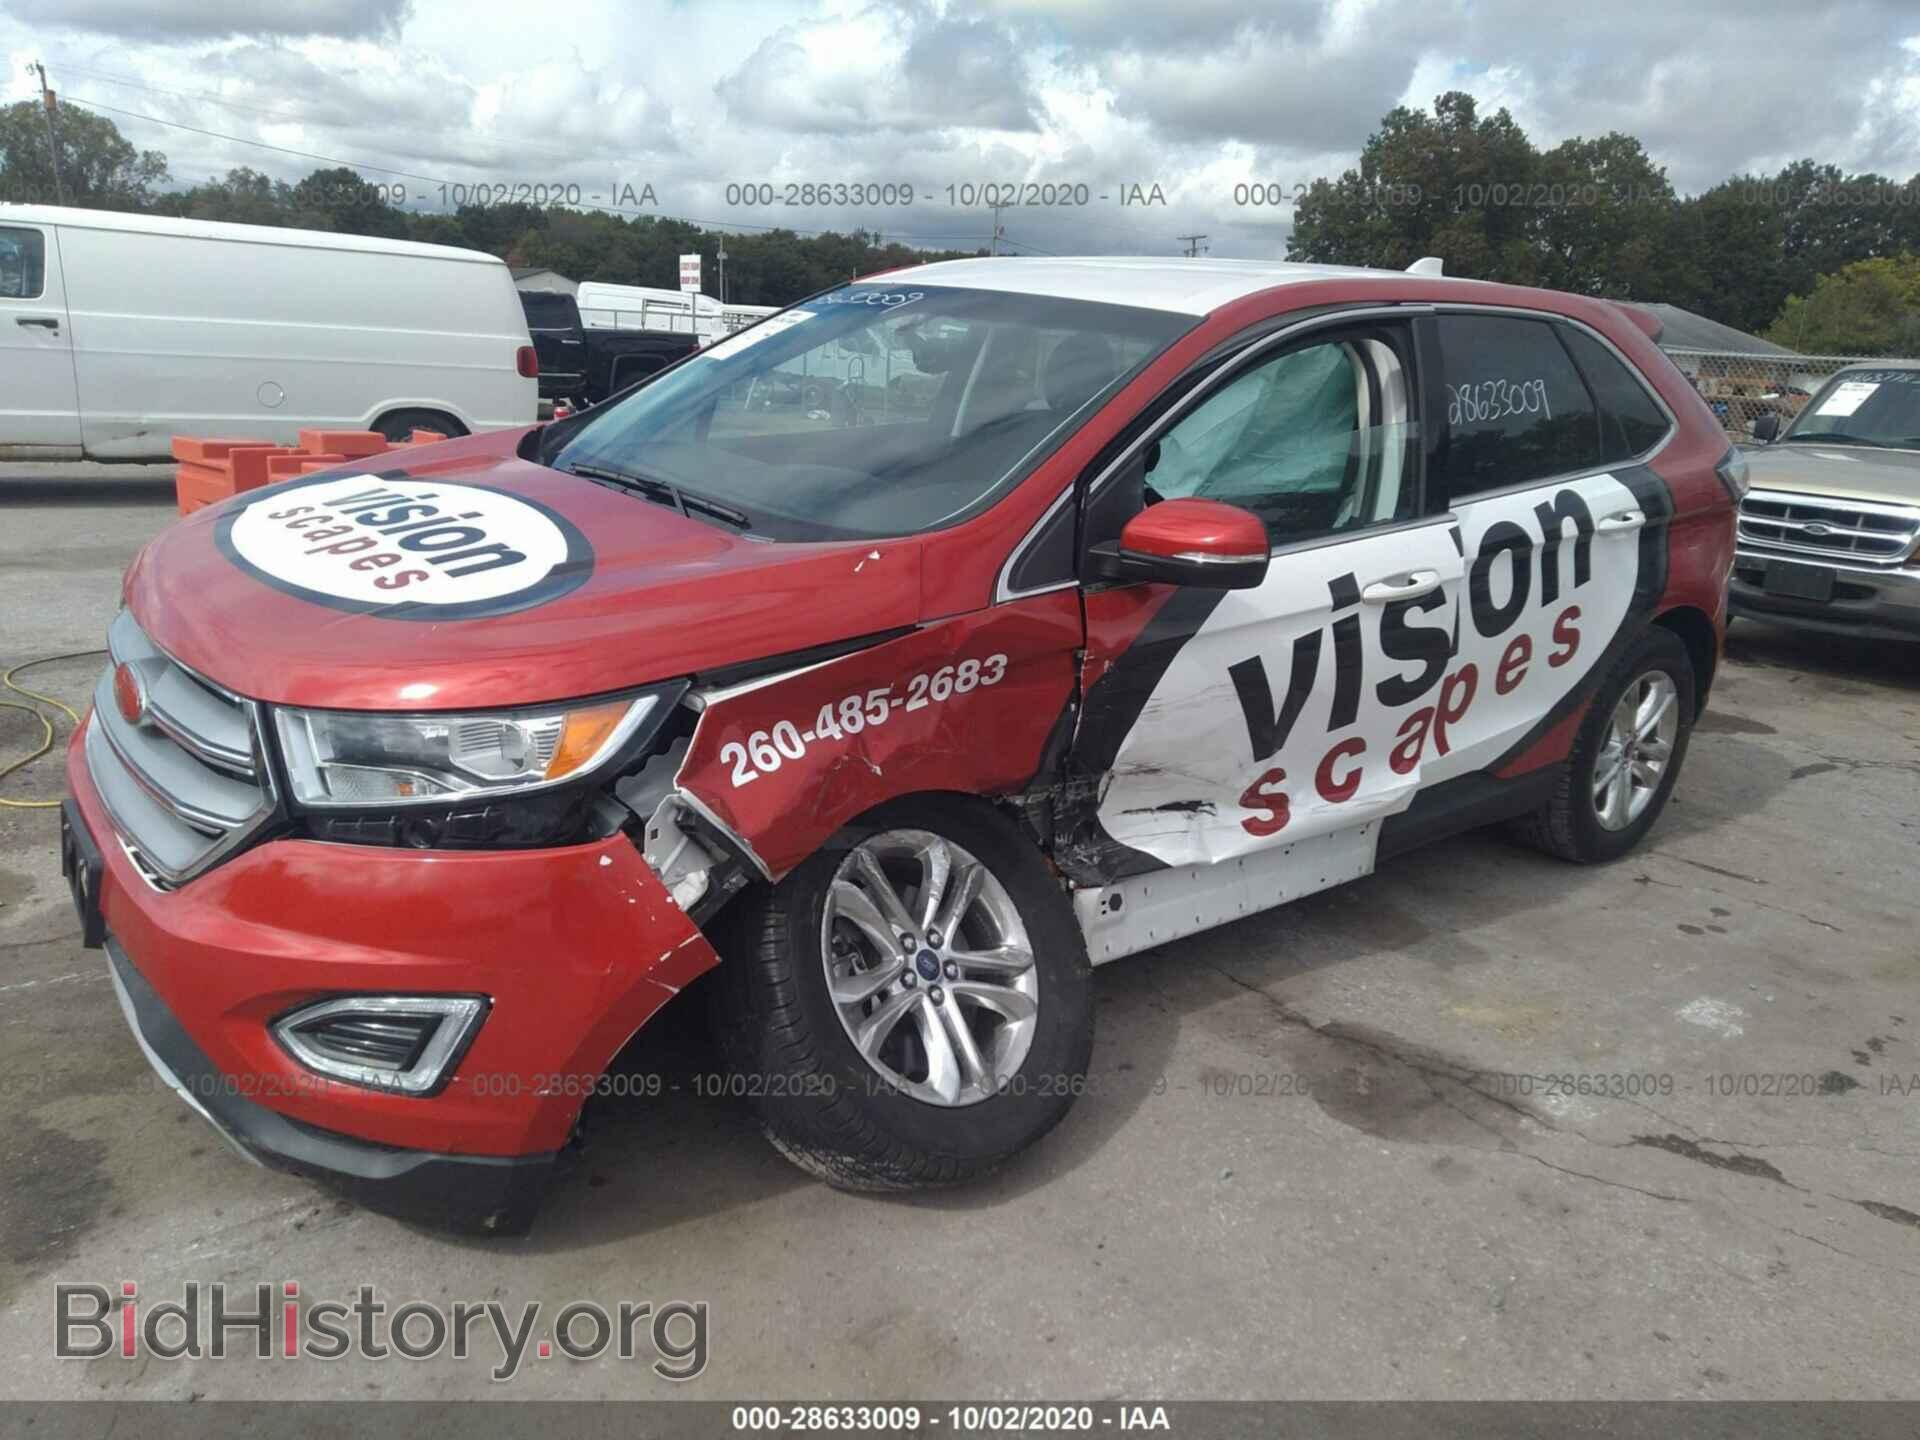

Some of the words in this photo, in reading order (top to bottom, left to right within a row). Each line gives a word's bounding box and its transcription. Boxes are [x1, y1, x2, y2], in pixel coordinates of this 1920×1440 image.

[1445, 379, 1551, 424] 28633009
[268, 505, 430, 590] scapes
[322, 487, 527, 579] vision
[719, 653, 1008, 788] 260-485-2683
[1238, 605, 1582, 837] scapes
